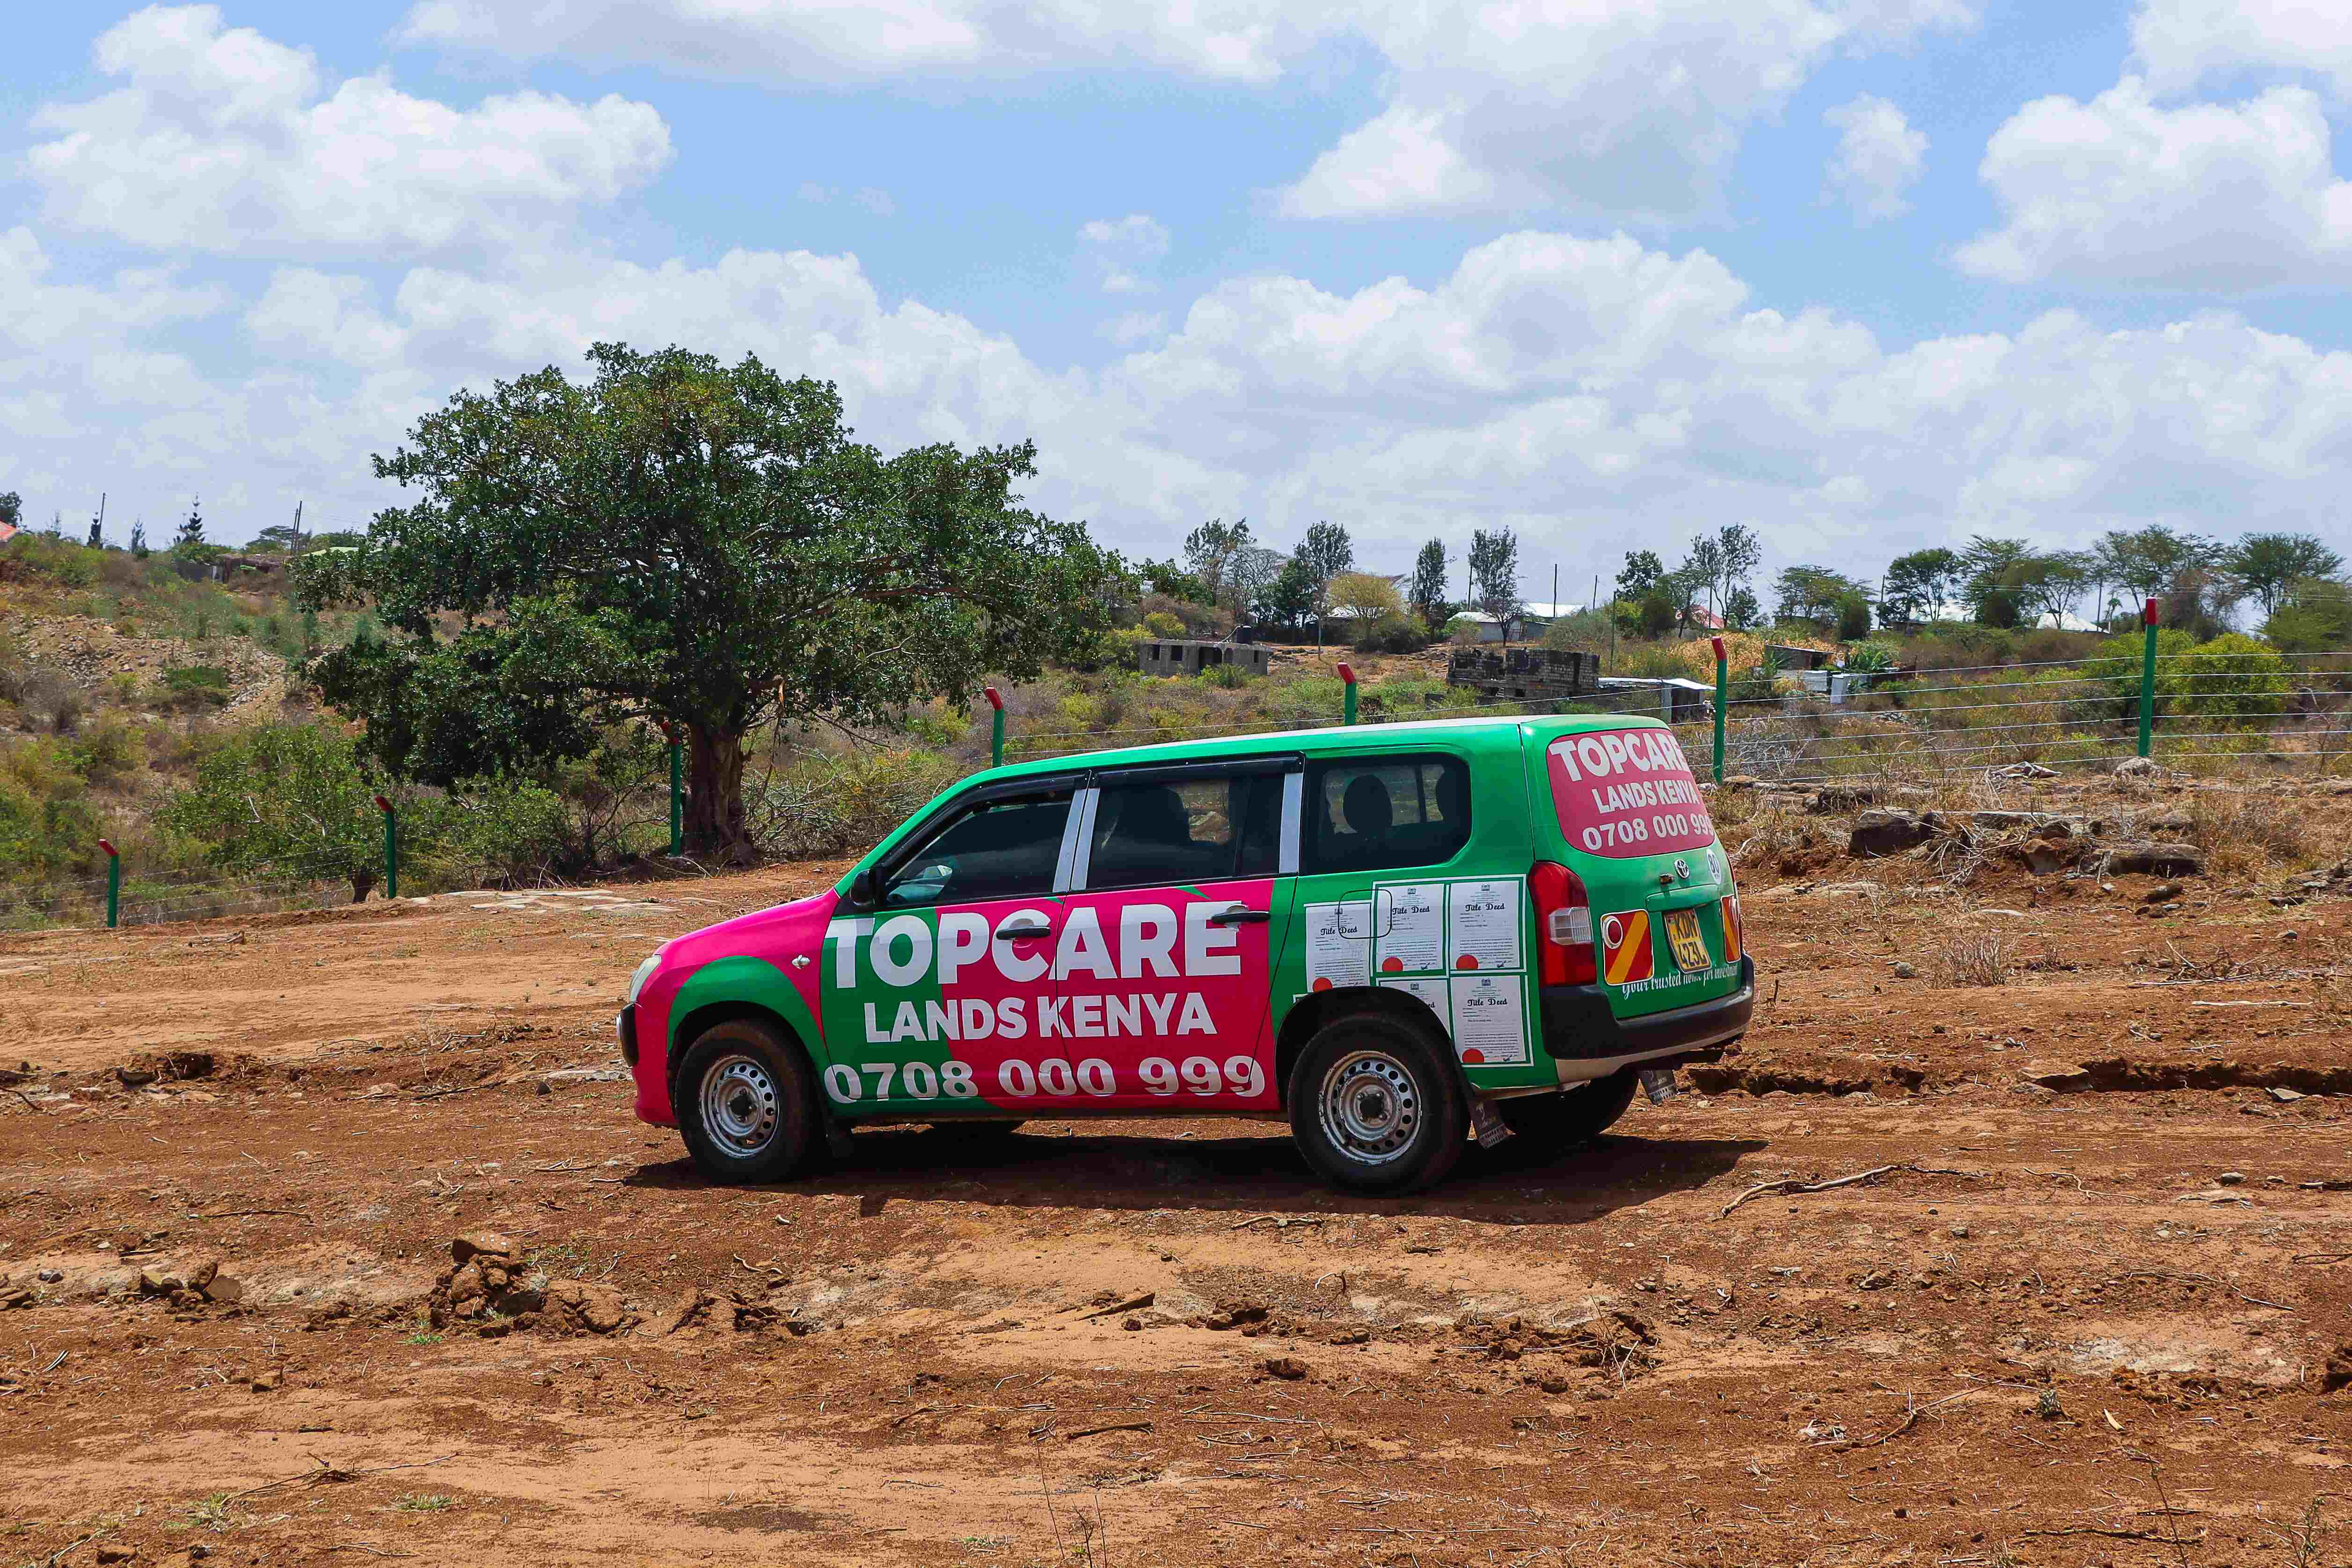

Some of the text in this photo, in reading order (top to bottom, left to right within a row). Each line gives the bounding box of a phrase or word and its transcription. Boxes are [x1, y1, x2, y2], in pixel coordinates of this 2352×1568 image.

[1592, 780, 1700, 813] LANDS KENYA
[1583, 818, 1648, 850] 0708
[1653, 814, 1688, 838] 000
[825, 900, 1242, 988] TOPCARE
[1651, 970, 1681, 990] trusted
[864, 992, 1217, 1043] LANDS KENYA
[824, 1055, 1265, 1103] 0708 000 999
